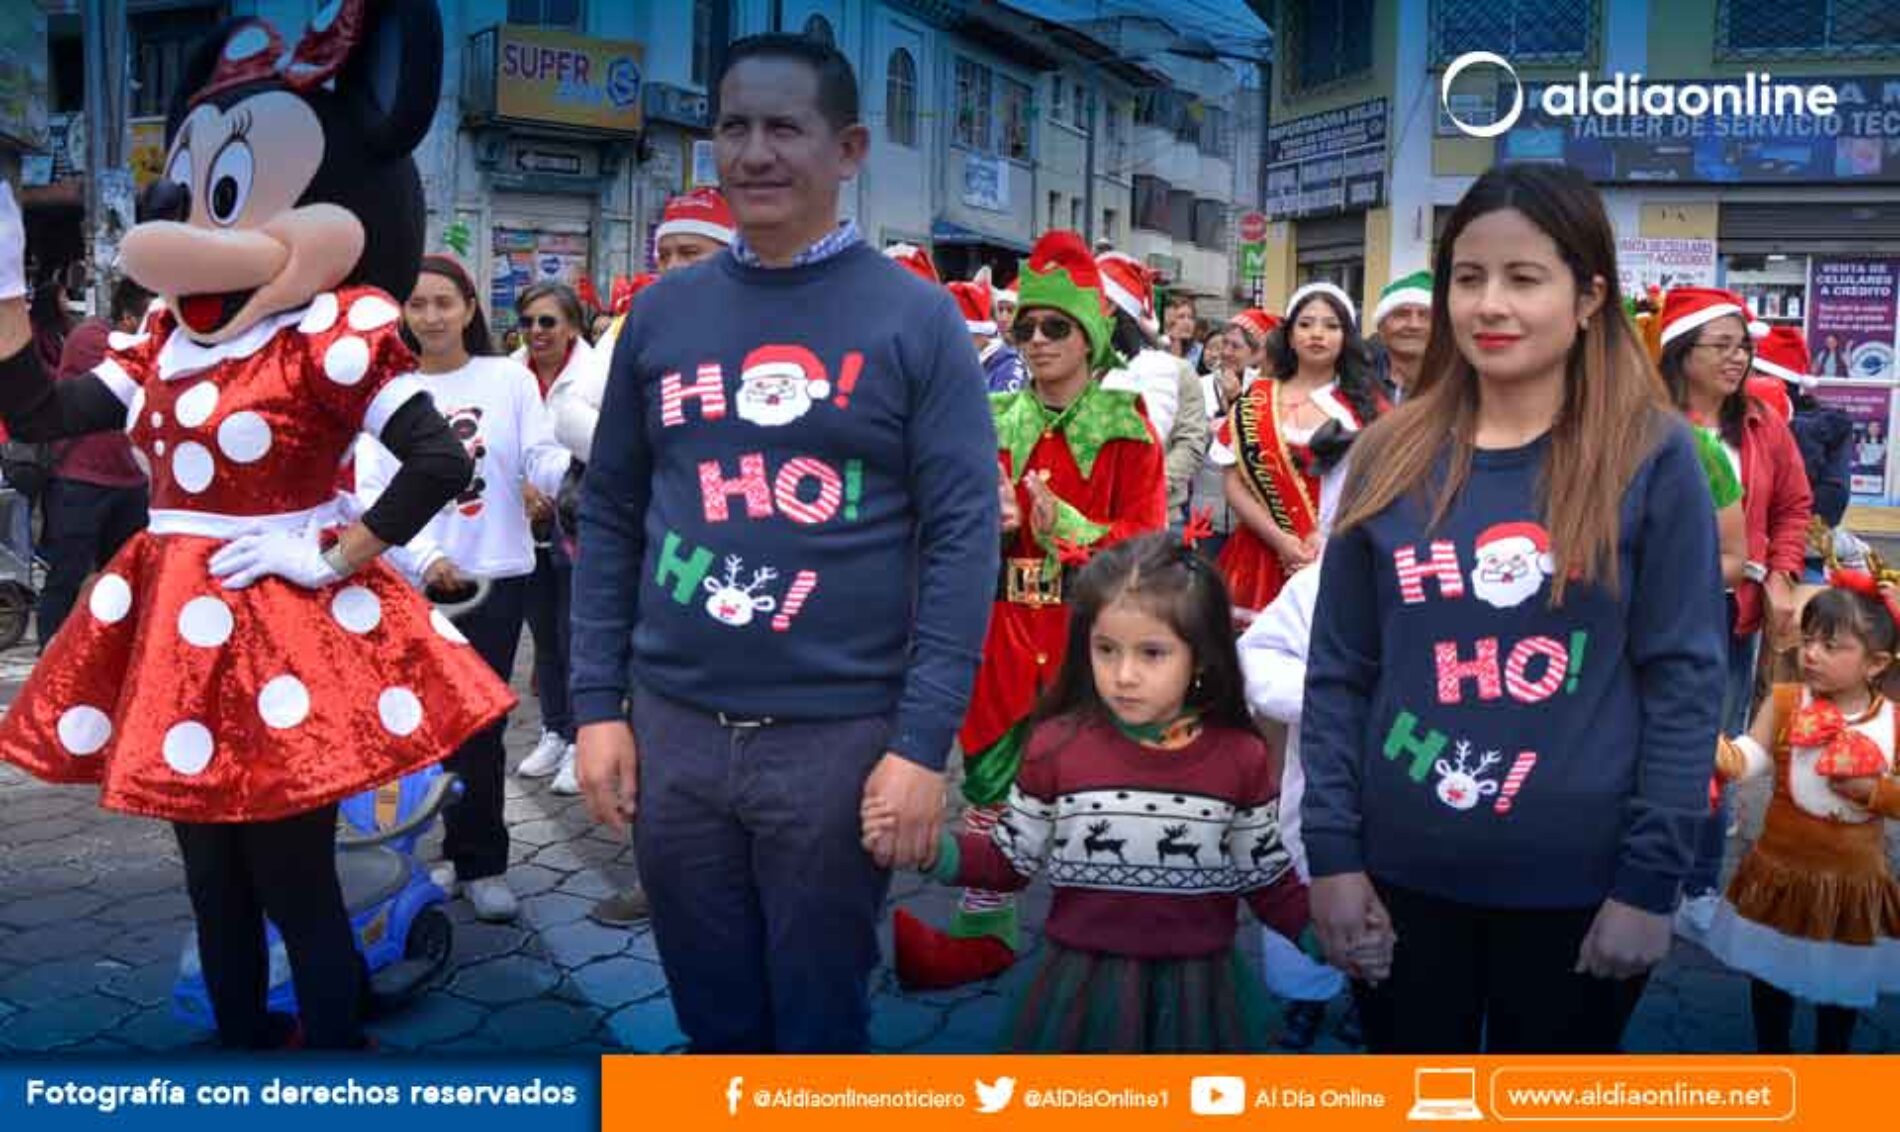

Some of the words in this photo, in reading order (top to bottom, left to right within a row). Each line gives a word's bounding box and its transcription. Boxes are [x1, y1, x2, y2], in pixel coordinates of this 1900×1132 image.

[503, 43, 590, 86] SUPER
[1572, 114, 1664, 138] TALLER
[1672, 114, 1707, 138] DE
[1716, 112, 1843, 137] SERVICIO
[1815, 274, 1893, 286] CELULARES
[698, 452, 863, 523] HO!
[1434, 630, 1588, 705] HO!
